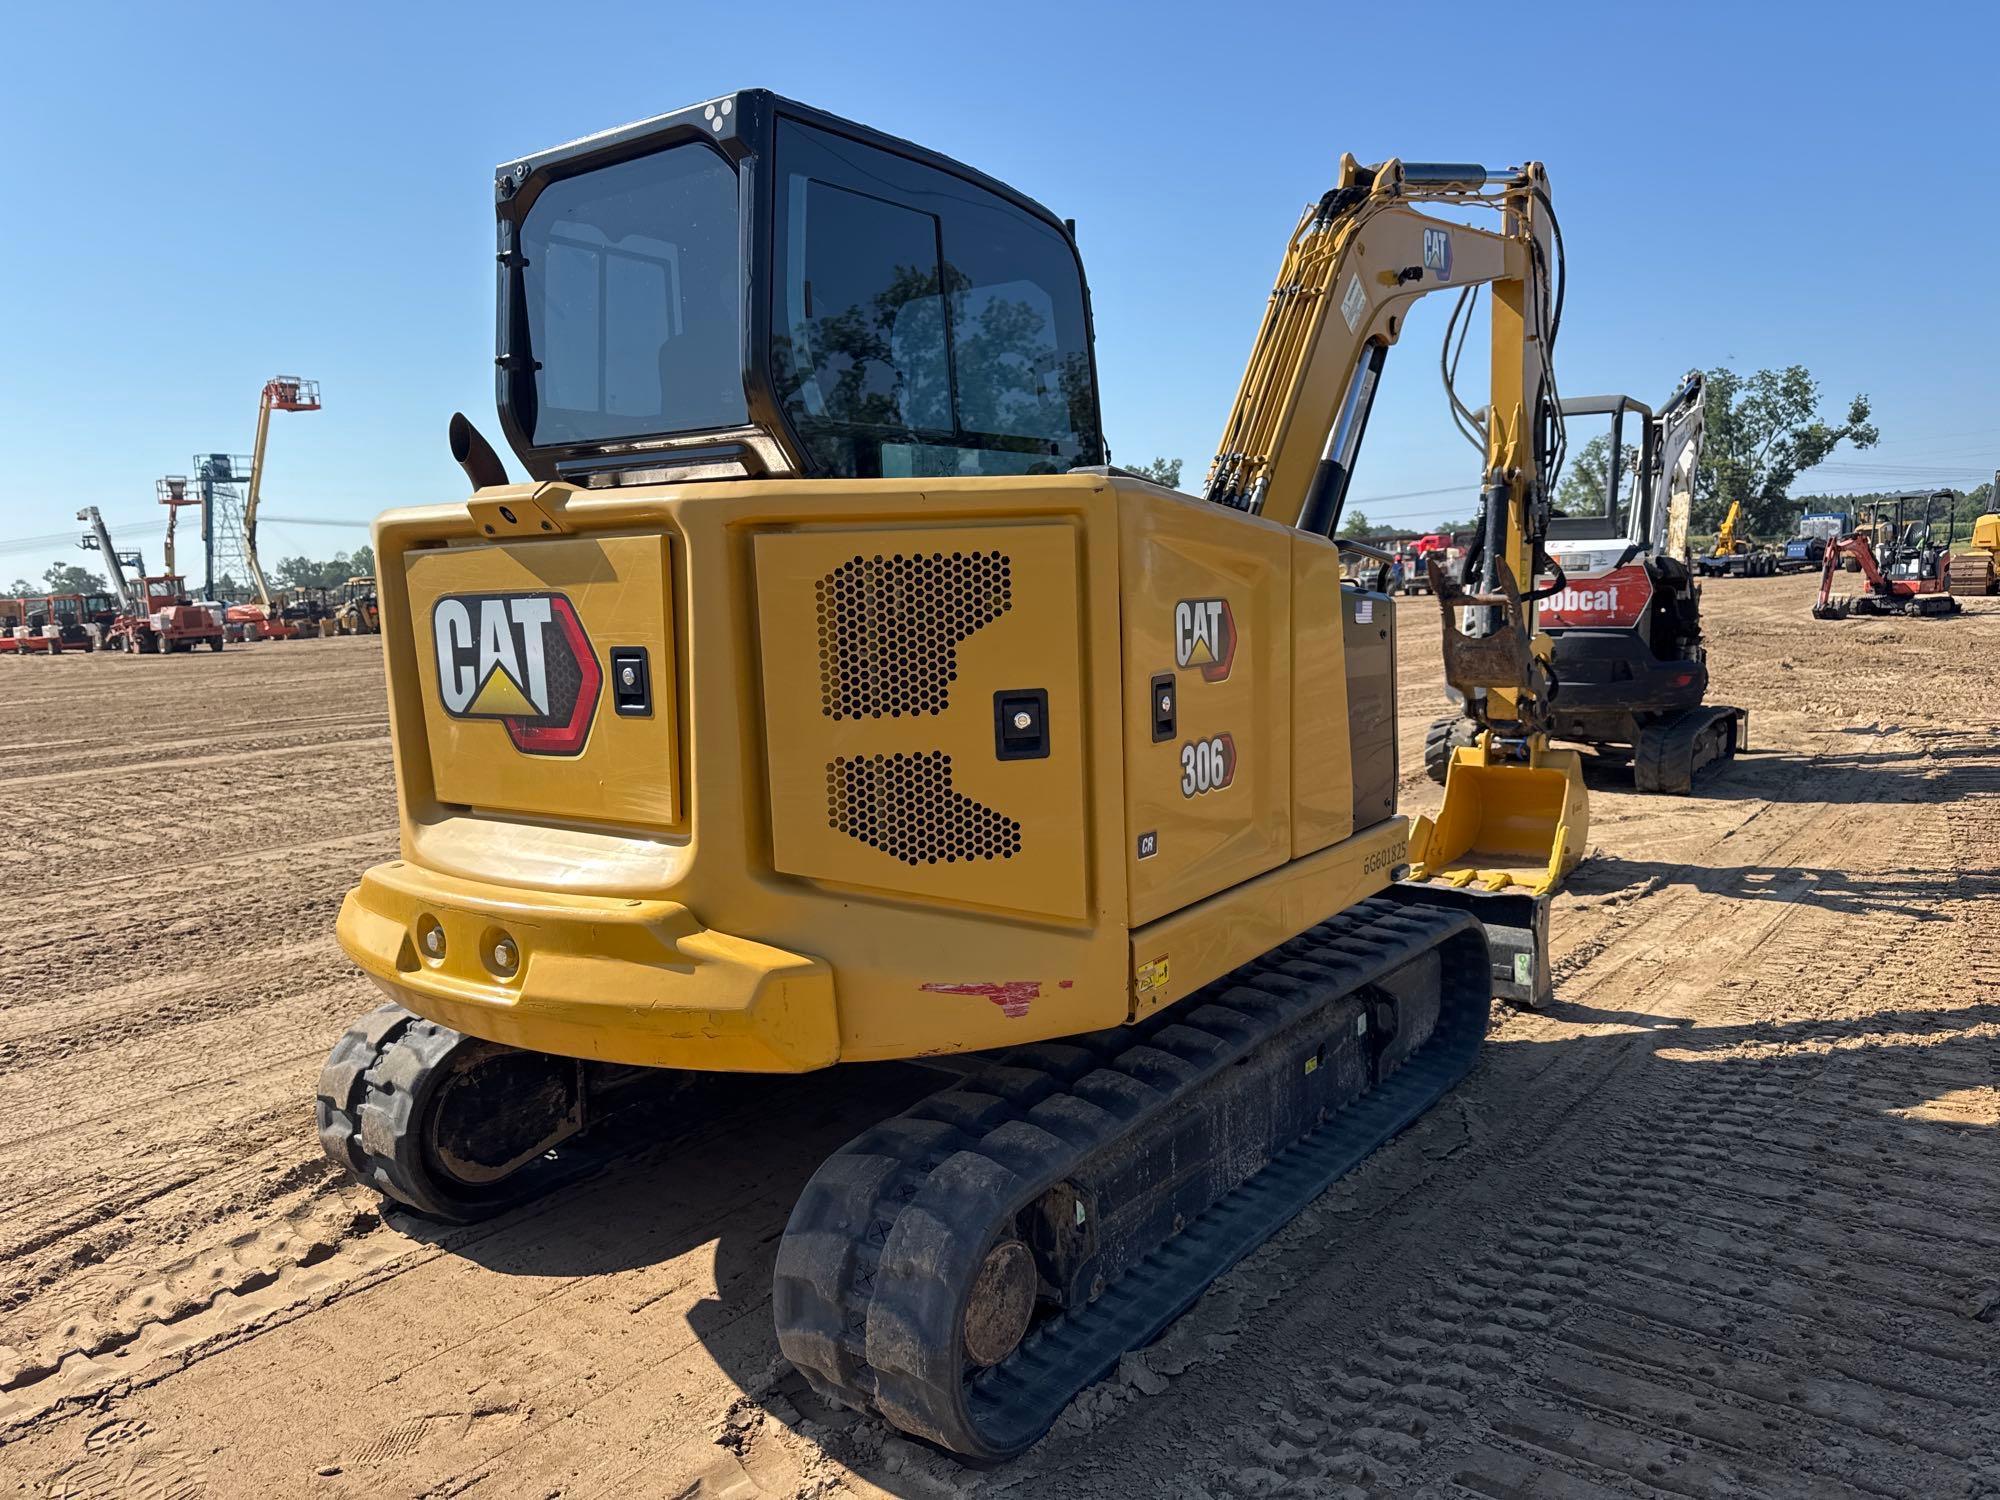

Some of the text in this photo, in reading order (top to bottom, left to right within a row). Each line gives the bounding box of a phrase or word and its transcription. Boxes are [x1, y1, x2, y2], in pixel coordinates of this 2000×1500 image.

[1424, 229, 1446, 269] CAT
[1539, 585, 1618, 611] Bobcat
[1176, 601, 1222, 666] CAT
[435, 597, 552, 716] CAT
[1181, 738, 1224, 795] 306
[1142, 836, 1154, 854] CR
[1363, 840, 1406, 875] 6G601825
